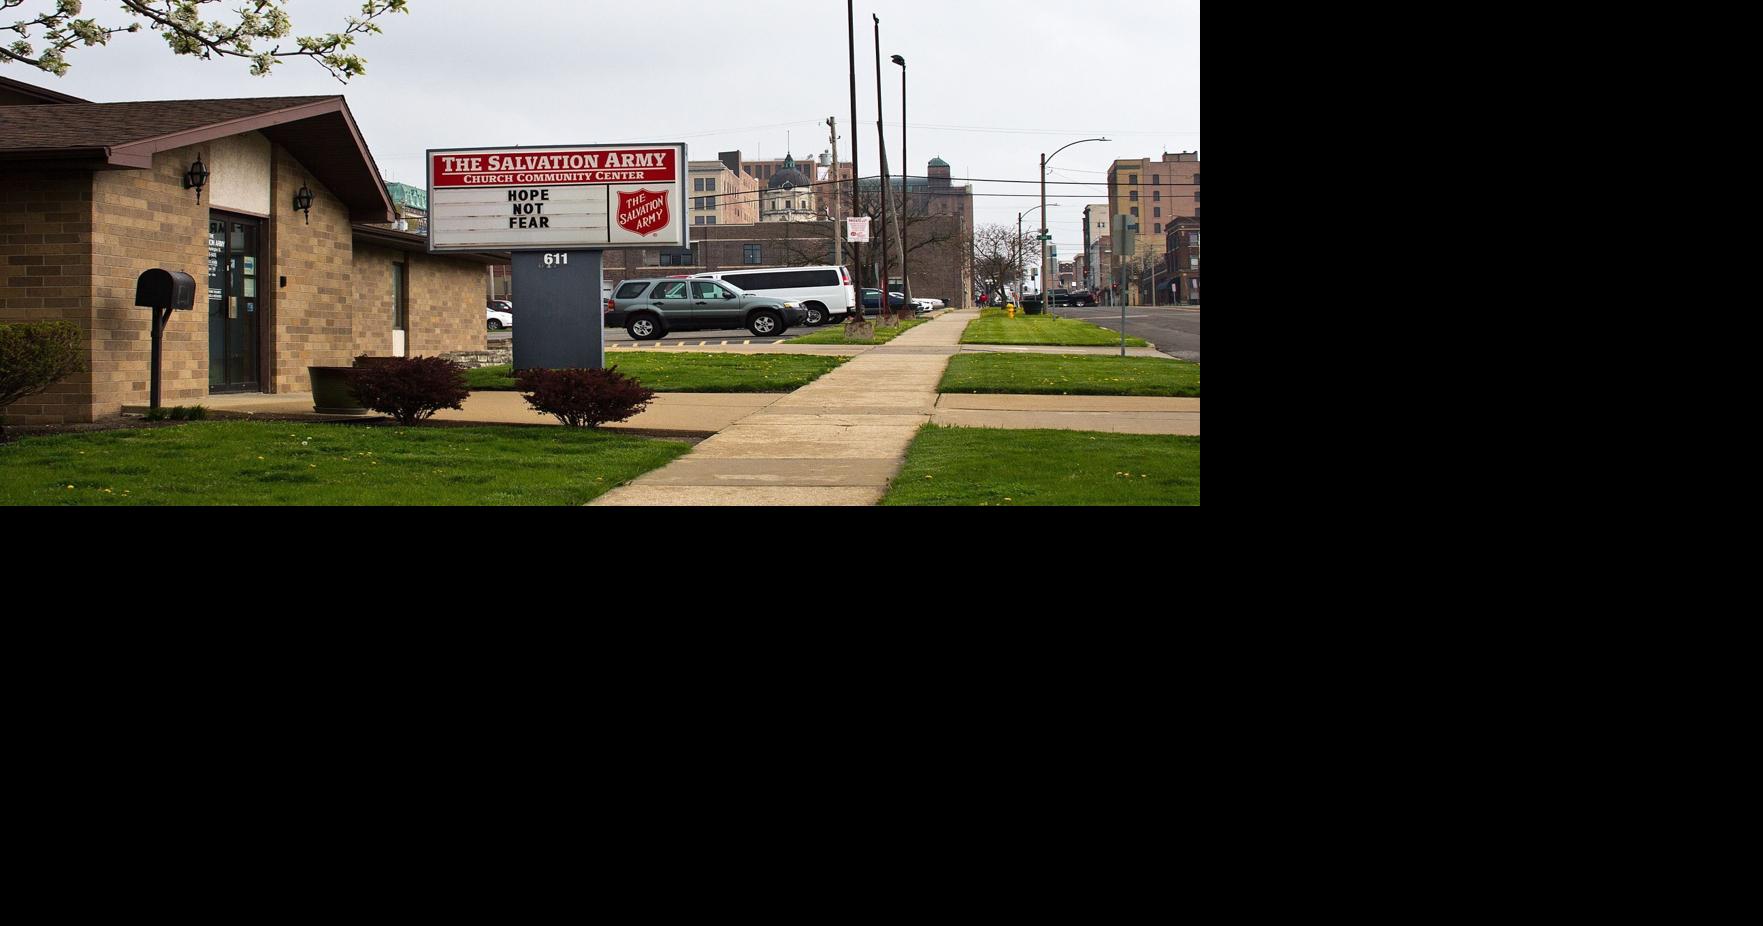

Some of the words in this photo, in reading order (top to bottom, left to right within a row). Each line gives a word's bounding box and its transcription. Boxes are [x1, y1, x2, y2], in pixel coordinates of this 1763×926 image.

[442, 157, 482, 172] THE
[488, 155, 599, 171] SALVATION
[604, 152, 666, 168] ARMY
[463, 174, 513, 185] CHURCH
[516, 172, 592, 183] COMMUNITY
[595, 171, 644, 180] CENTER
[508, 189, 549, 201] HOPE
[626, 193, 646, 209] THE
[513, 203, 543, 214] NOT
[620, 195, 664, 225] SALVATION
[509, 217, 549, 229] FEAR
[636, 208, 663, 230] ARMY
[543, 252, 568, 265] 611
